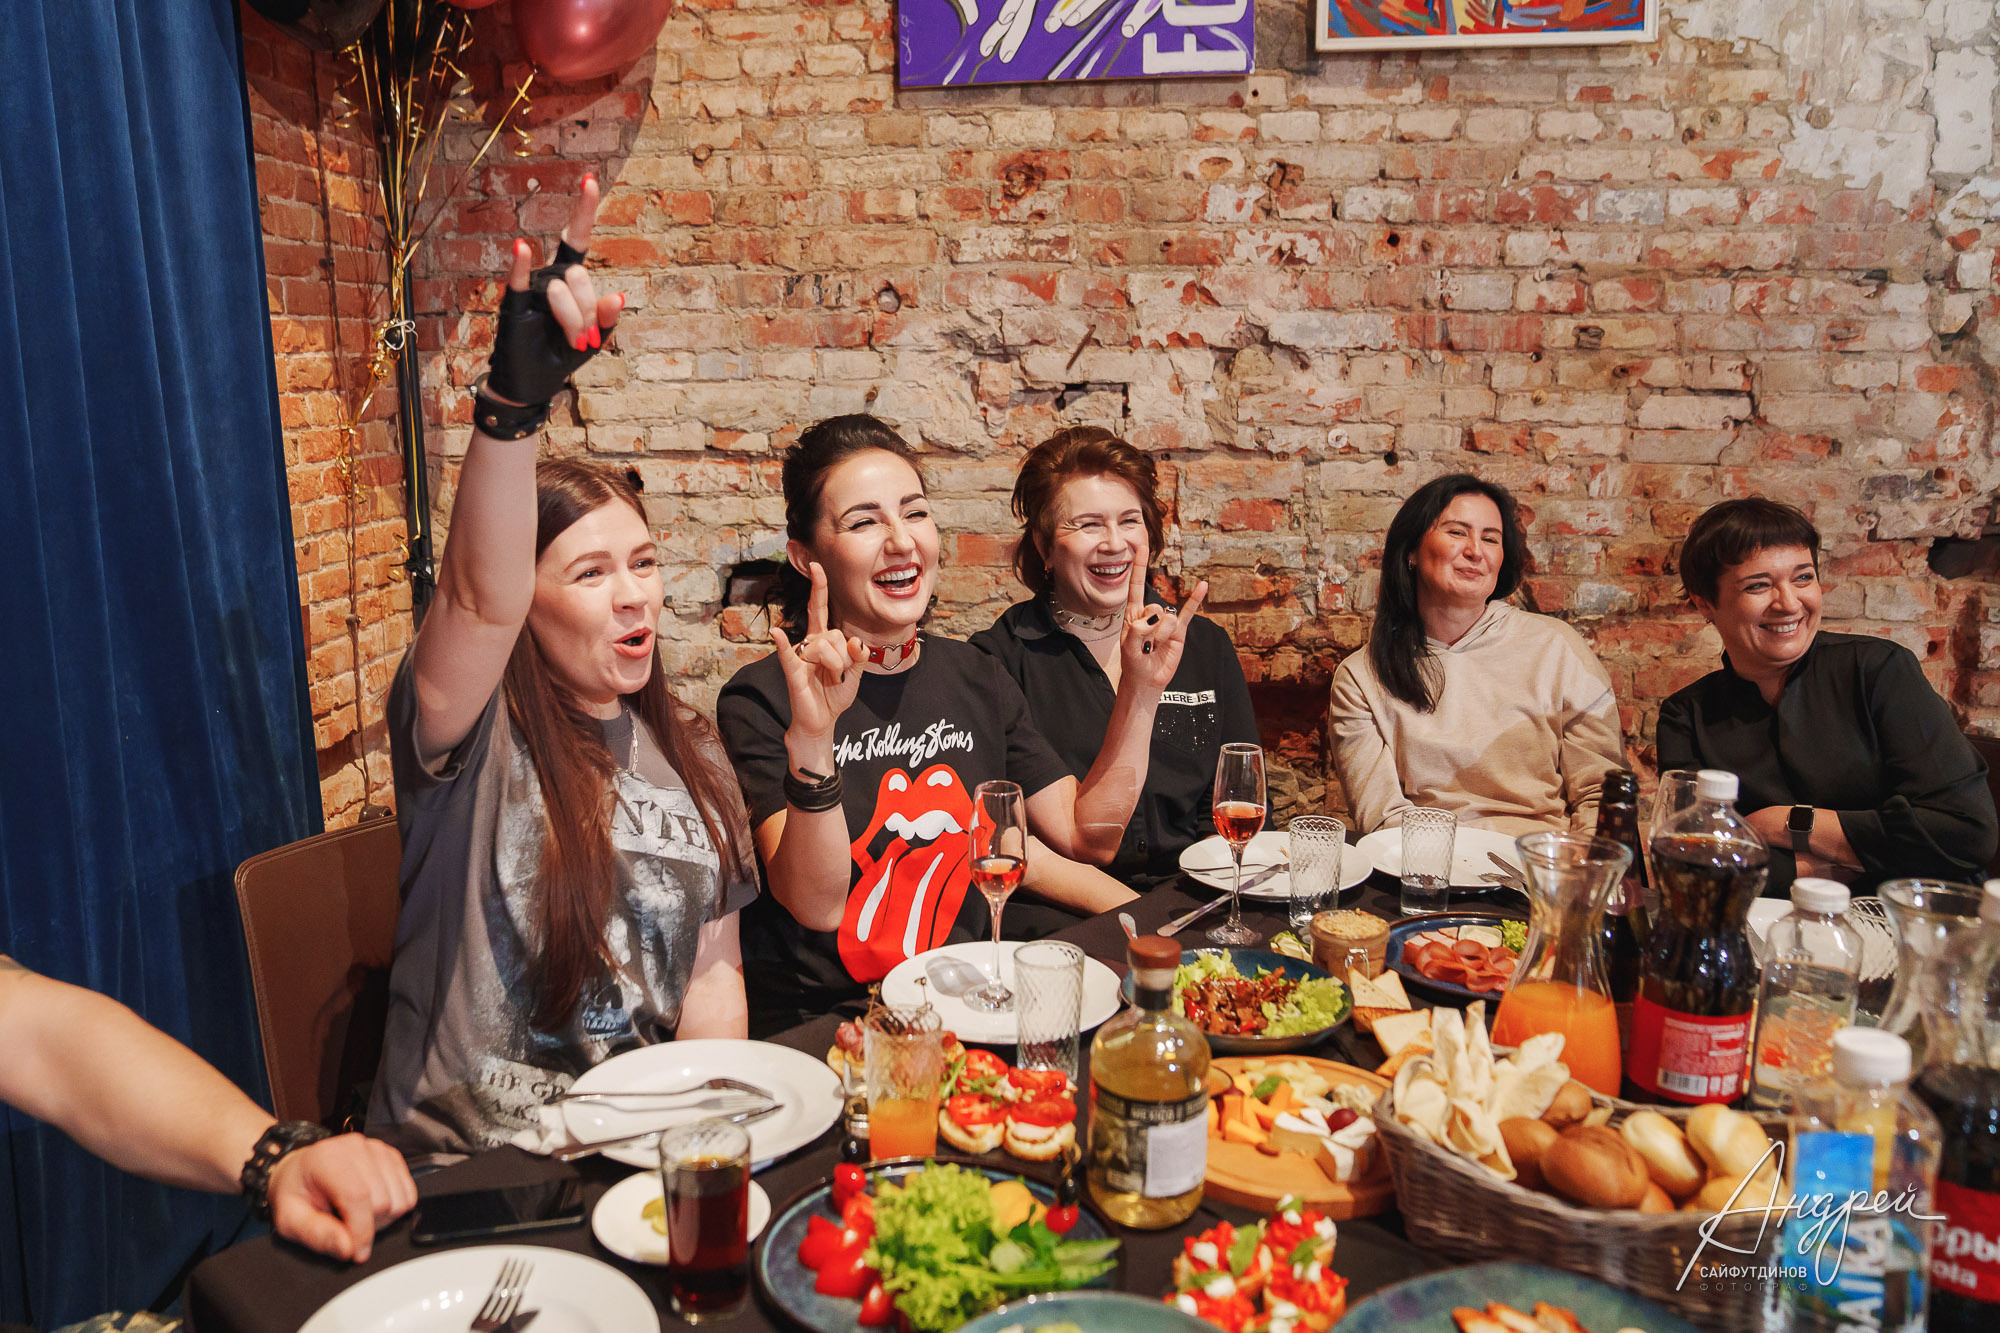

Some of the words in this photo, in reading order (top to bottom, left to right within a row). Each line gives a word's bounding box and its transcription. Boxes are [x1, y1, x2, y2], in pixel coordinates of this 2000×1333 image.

[1160, 693, 1194, 703] HERE
[1197, 694, 1209, 702] IS
[861, 722, 927, 769] Rolling
[924, 718, 974, 759] Stones
